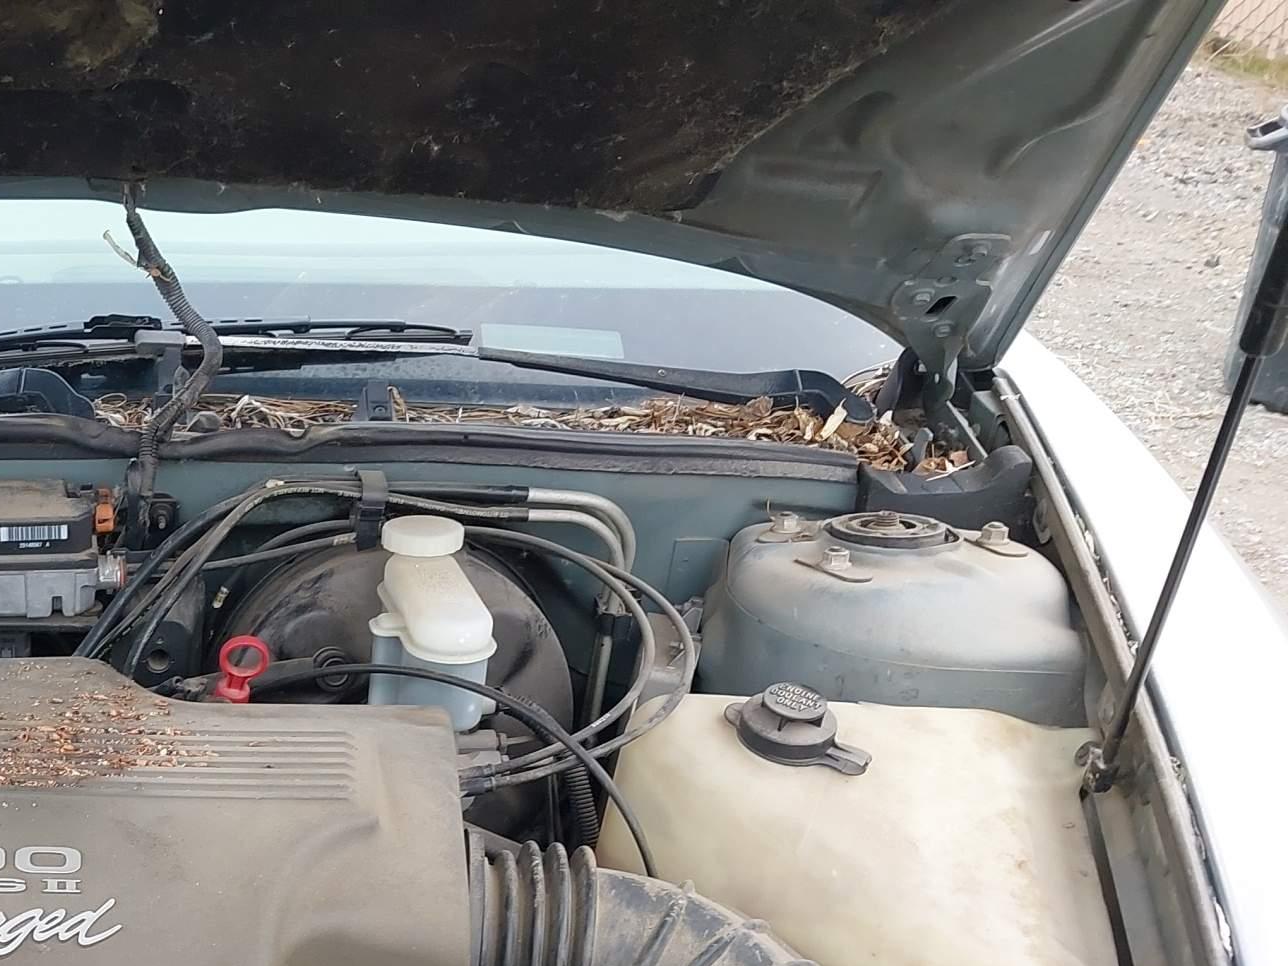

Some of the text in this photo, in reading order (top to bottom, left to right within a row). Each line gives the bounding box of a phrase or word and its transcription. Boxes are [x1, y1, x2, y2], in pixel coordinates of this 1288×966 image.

[770, 688, 822, 709] COOLANT
[778, 683, 820, 700] ENGINE
[776, 696, 807, 712] ONLY
[40, 878, 82, 894] II
